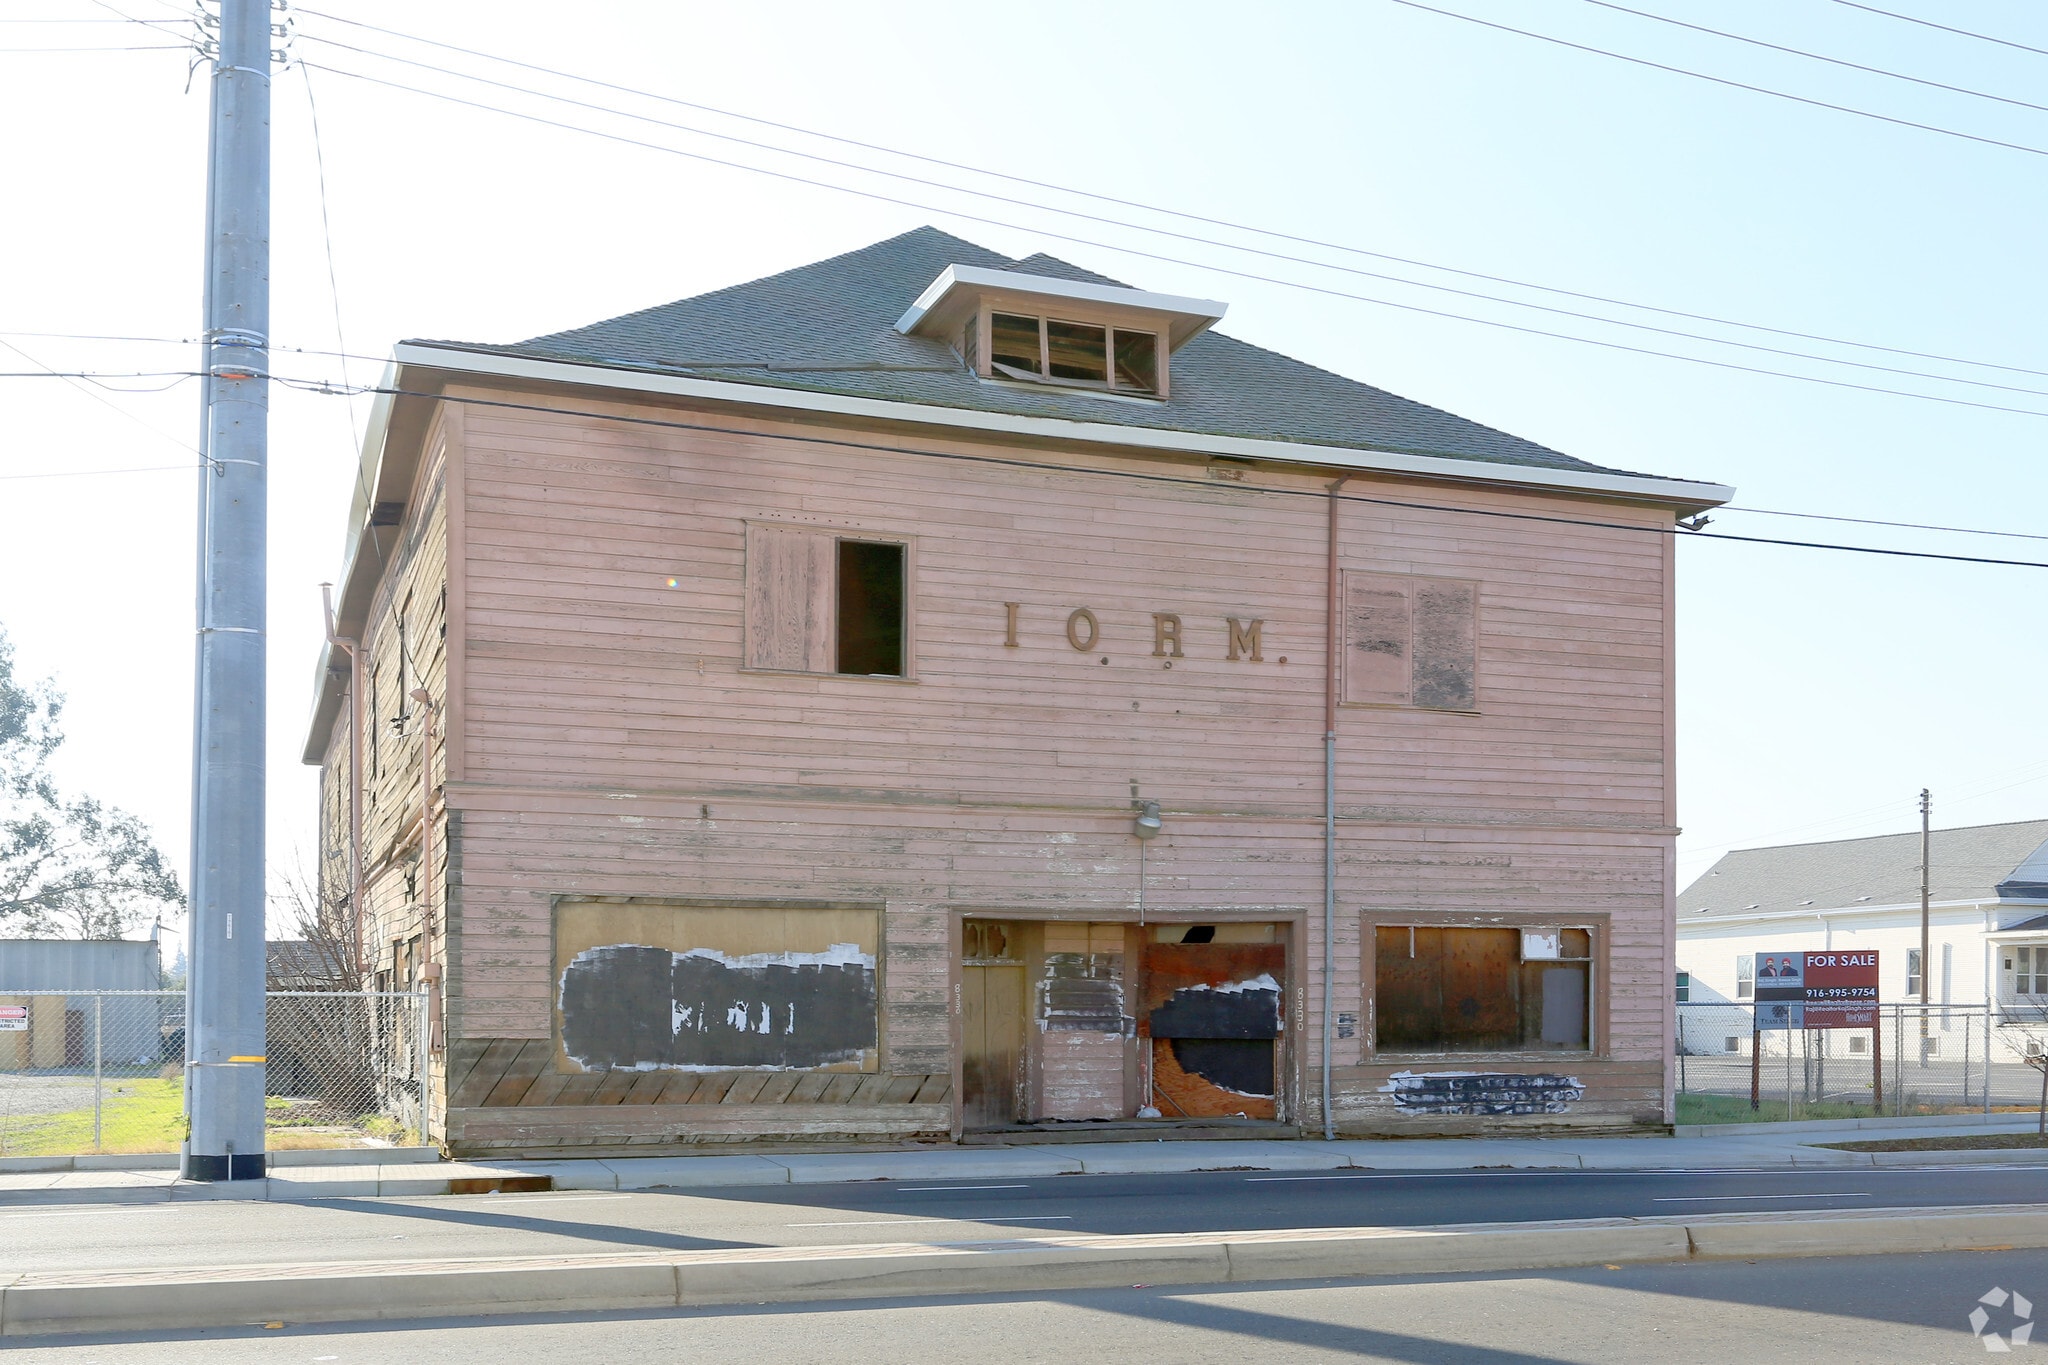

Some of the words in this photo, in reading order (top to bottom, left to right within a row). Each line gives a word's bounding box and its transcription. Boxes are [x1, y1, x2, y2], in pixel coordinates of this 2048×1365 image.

[1807, 955, 1836, 967] FOR
[1840, 954, 1876, 966] SALE
[1806, 987, 1876, 998] 916-995-9754
